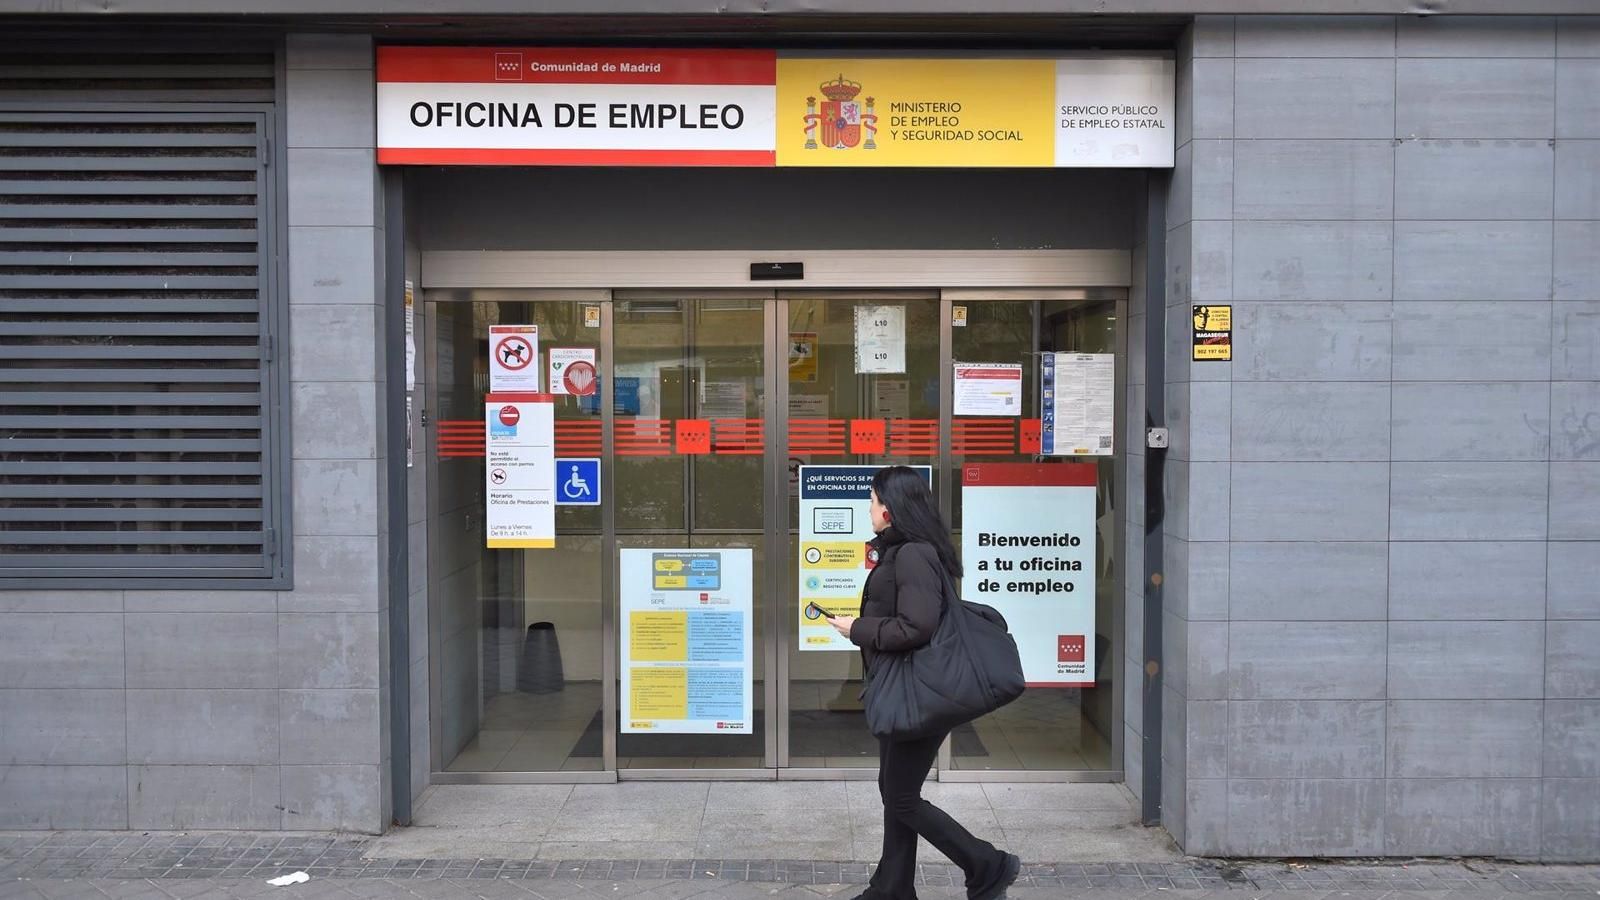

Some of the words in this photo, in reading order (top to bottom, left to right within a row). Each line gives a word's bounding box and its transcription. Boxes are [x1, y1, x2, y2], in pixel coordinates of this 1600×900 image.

[530, 61, 599, 73] Comunidad
[602, 62, 616, 73] de
[620, 62, 661, 74] Madrid
[890, 102, 961, 113] MINISTERIO
[1061, 105, 1108, 116] SERVICIO
[1112, 103, 1158, 116] PÚBLICO
[409, 101, 543, 128] OFICINA
[555, 103, 597, 128] DE
[609, 103, 745, 130] EMPLEO
[890, 116, 908, 127] DE
[911, 116, 959, 127] EMPLEO
[1061, 119, 1076, 129] DE
[1079, 119, 1120, 129] EMPLEO
[1123, 119, 1165, 129] ESTATAL
[890, 130, 898, 141] Y
[902, 130, 974, 141] SEGURIDAD
[978, 131, 1023, 142] SOCIAL
[806, 474, 823, 483] ¿QUÉ
[821, 521, 845, 530] SEPE
[978, 533, 1081, 547] Bienvenido
[978, 560, 988, 571] a
[994, 558, 1013, 571] tu
[1019, 557, 1082, 571] oficina
[978, 579, 1000, 592] de
[1006, 579, 1075, 595] empleo
